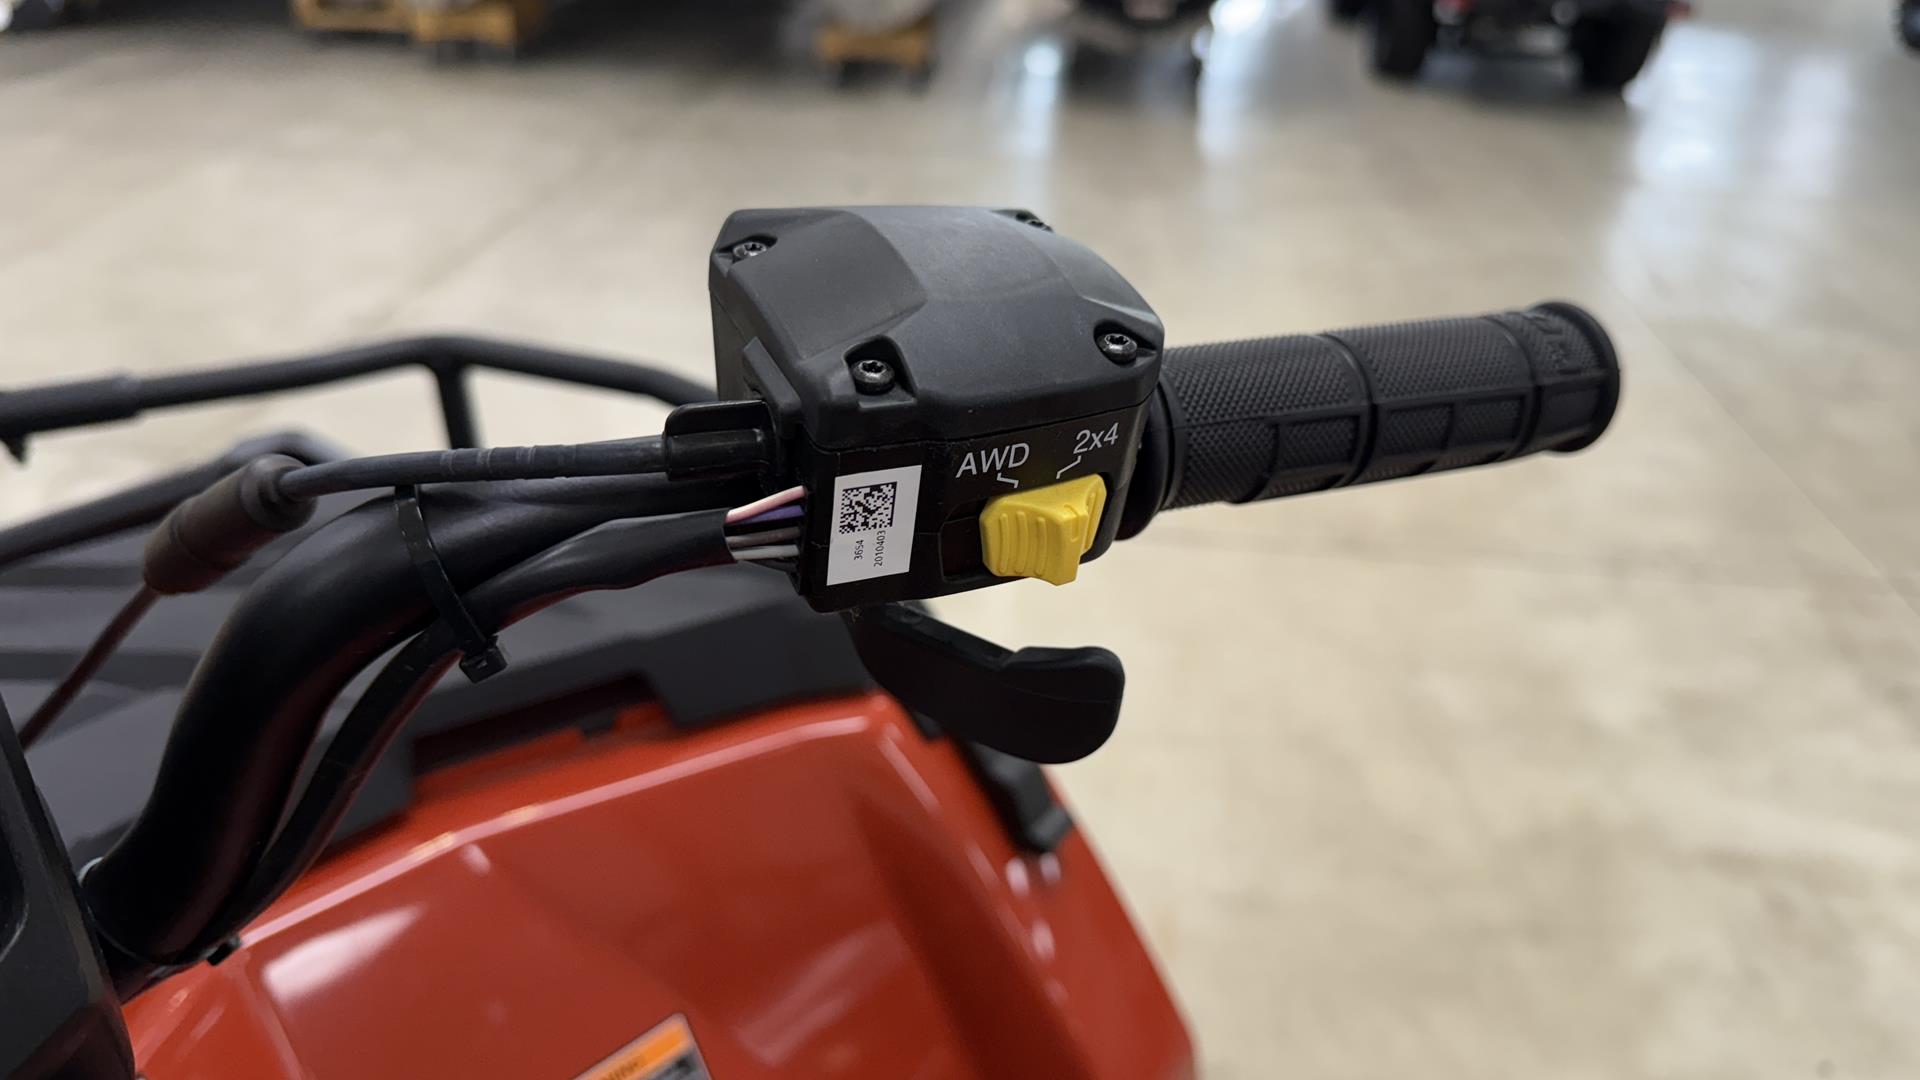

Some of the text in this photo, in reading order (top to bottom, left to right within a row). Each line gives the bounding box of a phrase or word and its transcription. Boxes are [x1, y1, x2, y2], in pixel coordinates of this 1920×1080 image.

[1073, 422, 1119, 454] 2x4
[955, 442, 1030, 478] AWD
[873, 530, 886, 567] 2010403
